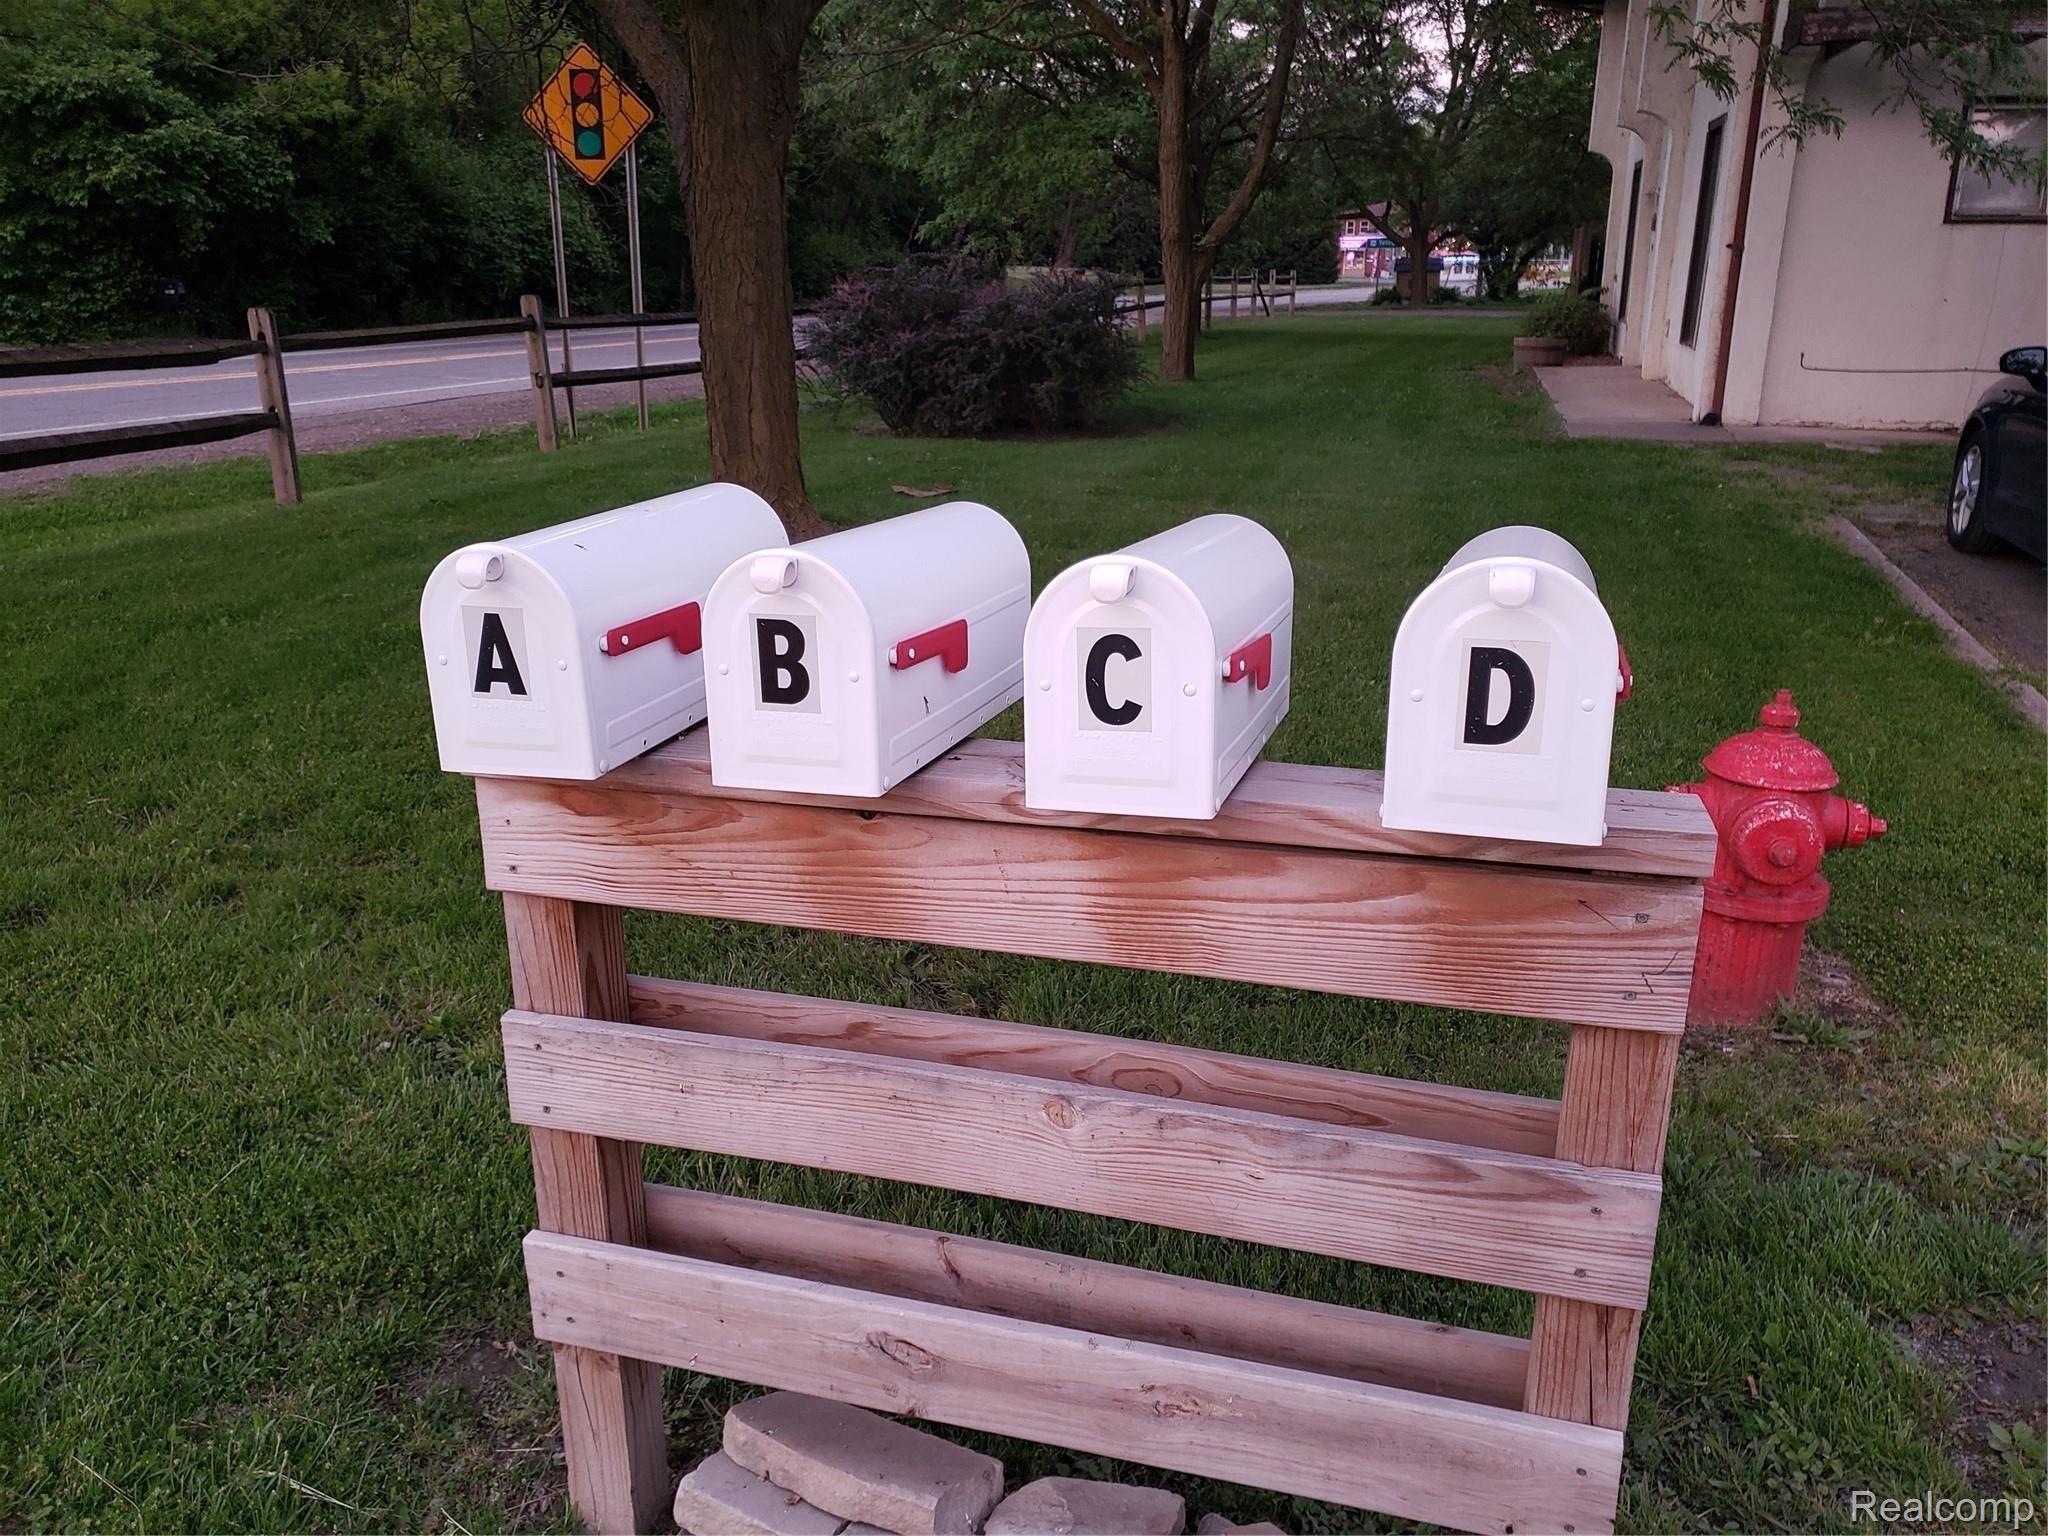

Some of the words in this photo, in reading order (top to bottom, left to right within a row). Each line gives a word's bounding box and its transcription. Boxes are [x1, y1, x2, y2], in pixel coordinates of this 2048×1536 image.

[474, 613, 527, 696] A
[757, 619, 810, 705] B
[1085, 634, 1143, 726] C
[1463, 647, 1535, 746] D
